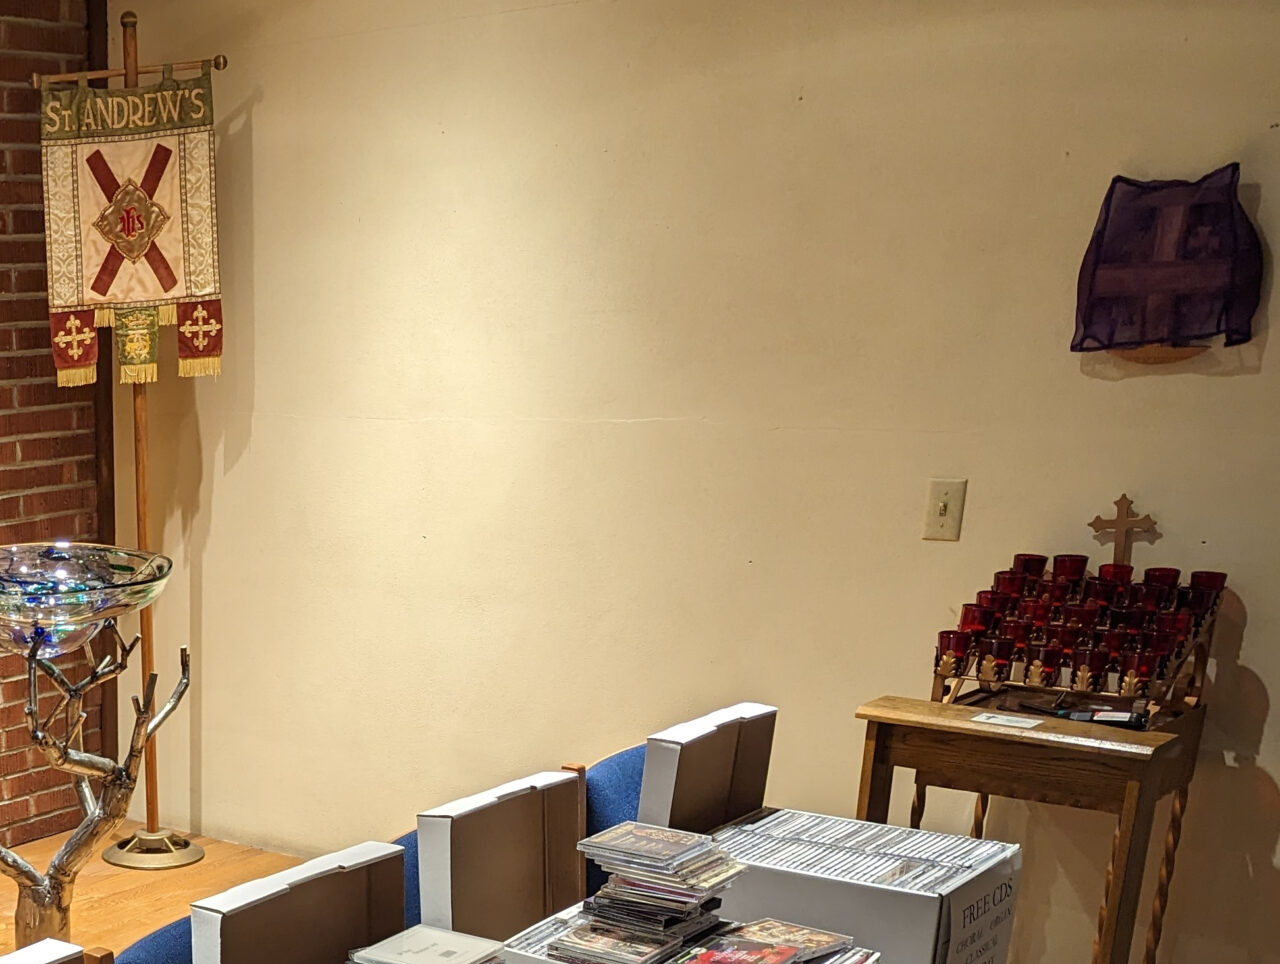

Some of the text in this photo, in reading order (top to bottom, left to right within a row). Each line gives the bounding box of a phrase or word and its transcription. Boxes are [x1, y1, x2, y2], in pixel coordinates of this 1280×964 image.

[45, 88, 205, 132] ST. ANDREW'S
[962, 878, 1012, 928] FREE CDS
